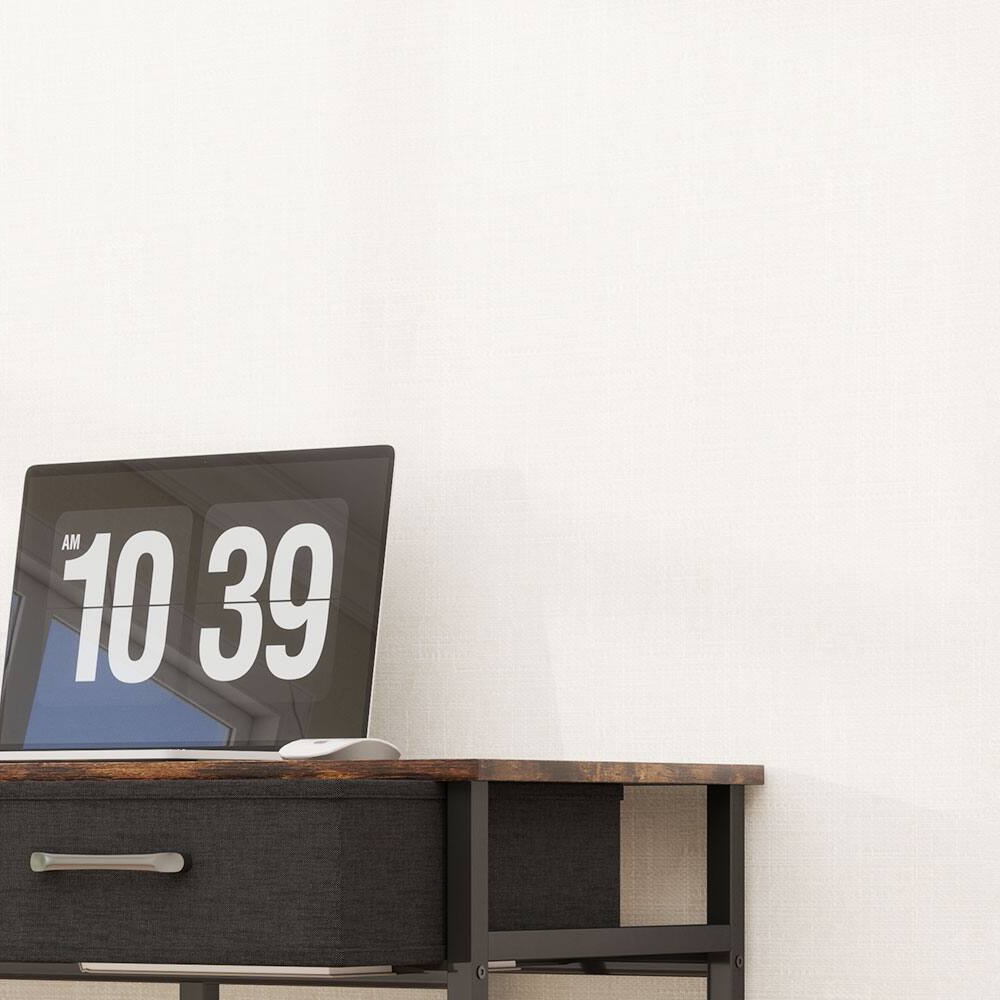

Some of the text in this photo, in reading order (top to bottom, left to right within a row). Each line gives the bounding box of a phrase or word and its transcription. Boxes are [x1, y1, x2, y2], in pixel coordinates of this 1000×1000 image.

[61, 533, 80, 550] AM
[63, 522, 334, 684] 10 39
